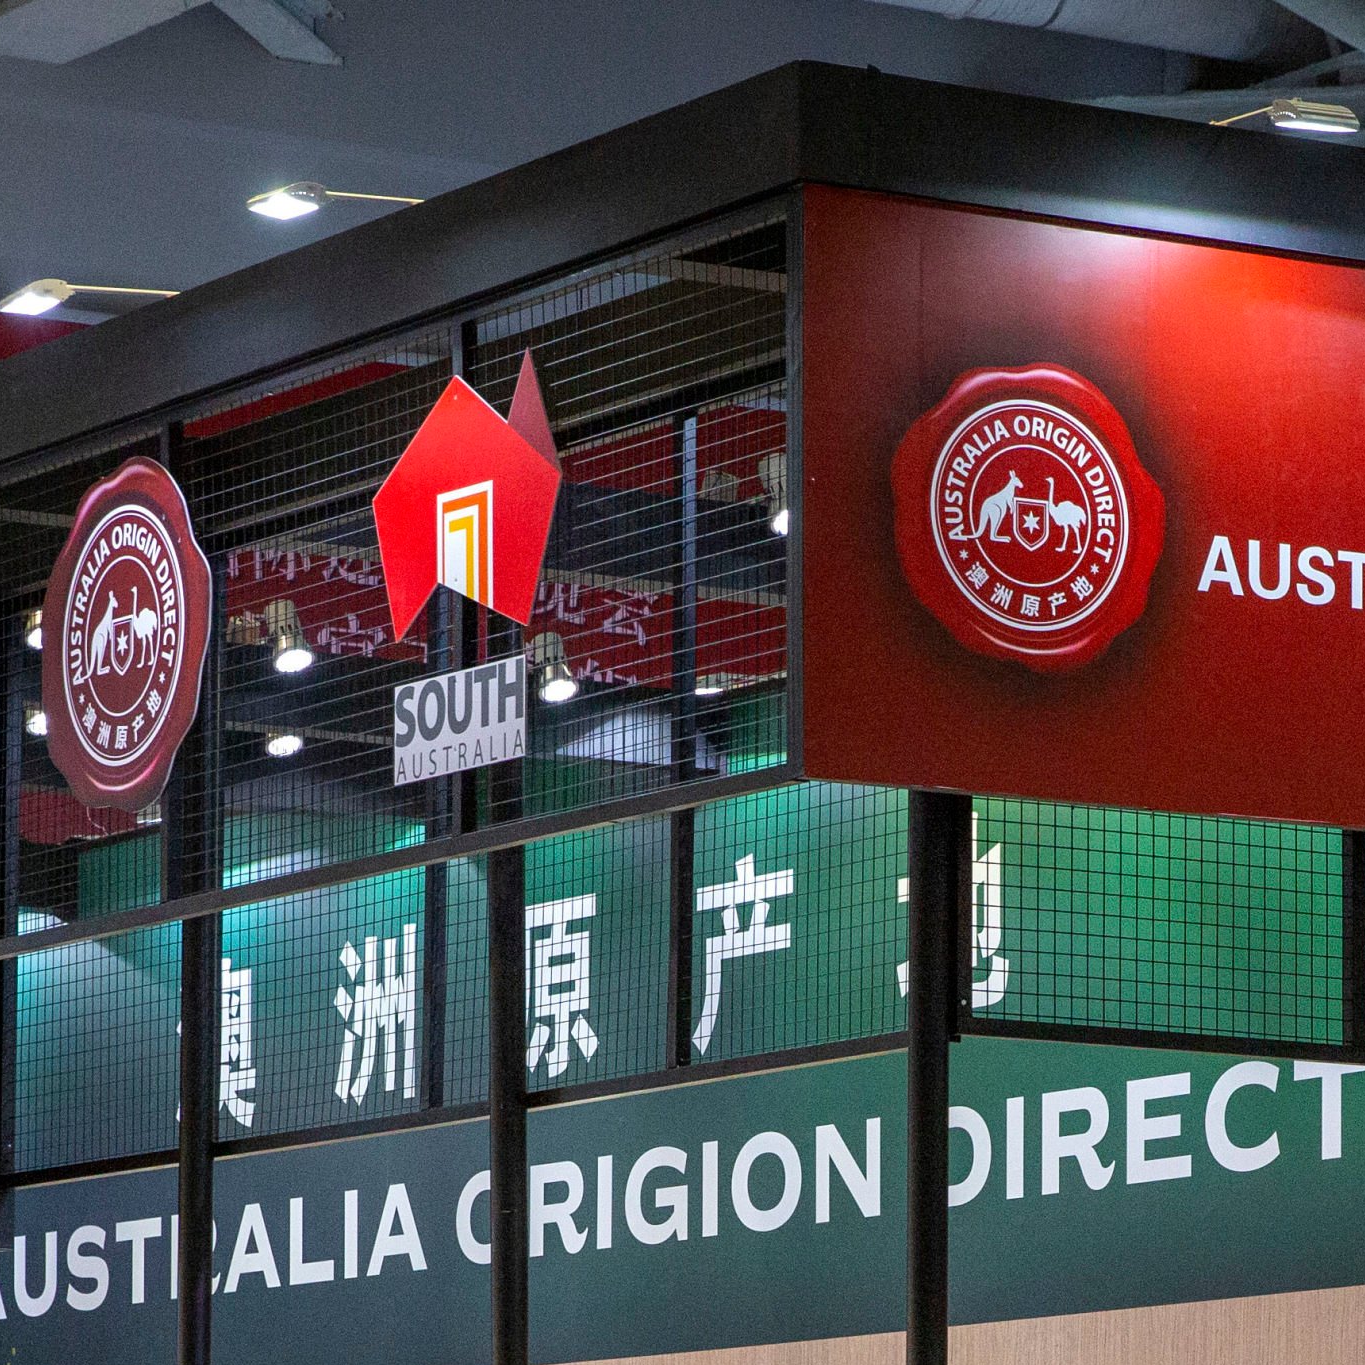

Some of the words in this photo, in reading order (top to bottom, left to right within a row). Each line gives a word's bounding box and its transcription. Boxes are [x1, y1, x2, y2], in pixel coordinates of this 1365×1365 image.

[944, 419, 1011, 541] AUSTRALIA
[1013, 414, 1093, 468] ORIGIN
[1084, 465, 1116, 563] DIRECT
[69, 537, 111, 686] AUSTRALIA
[111, 522, 162, 565] ORIGIN
[156, 558, 177, 667] DIRECT
[965, 561, 1095, 617] 澳洲原产地
[82, 688, 162, 750] 澳洲原产地
[395, 656, 524, 748] SOUTH
[395, 727, 525, 786] AUSTRALIA
